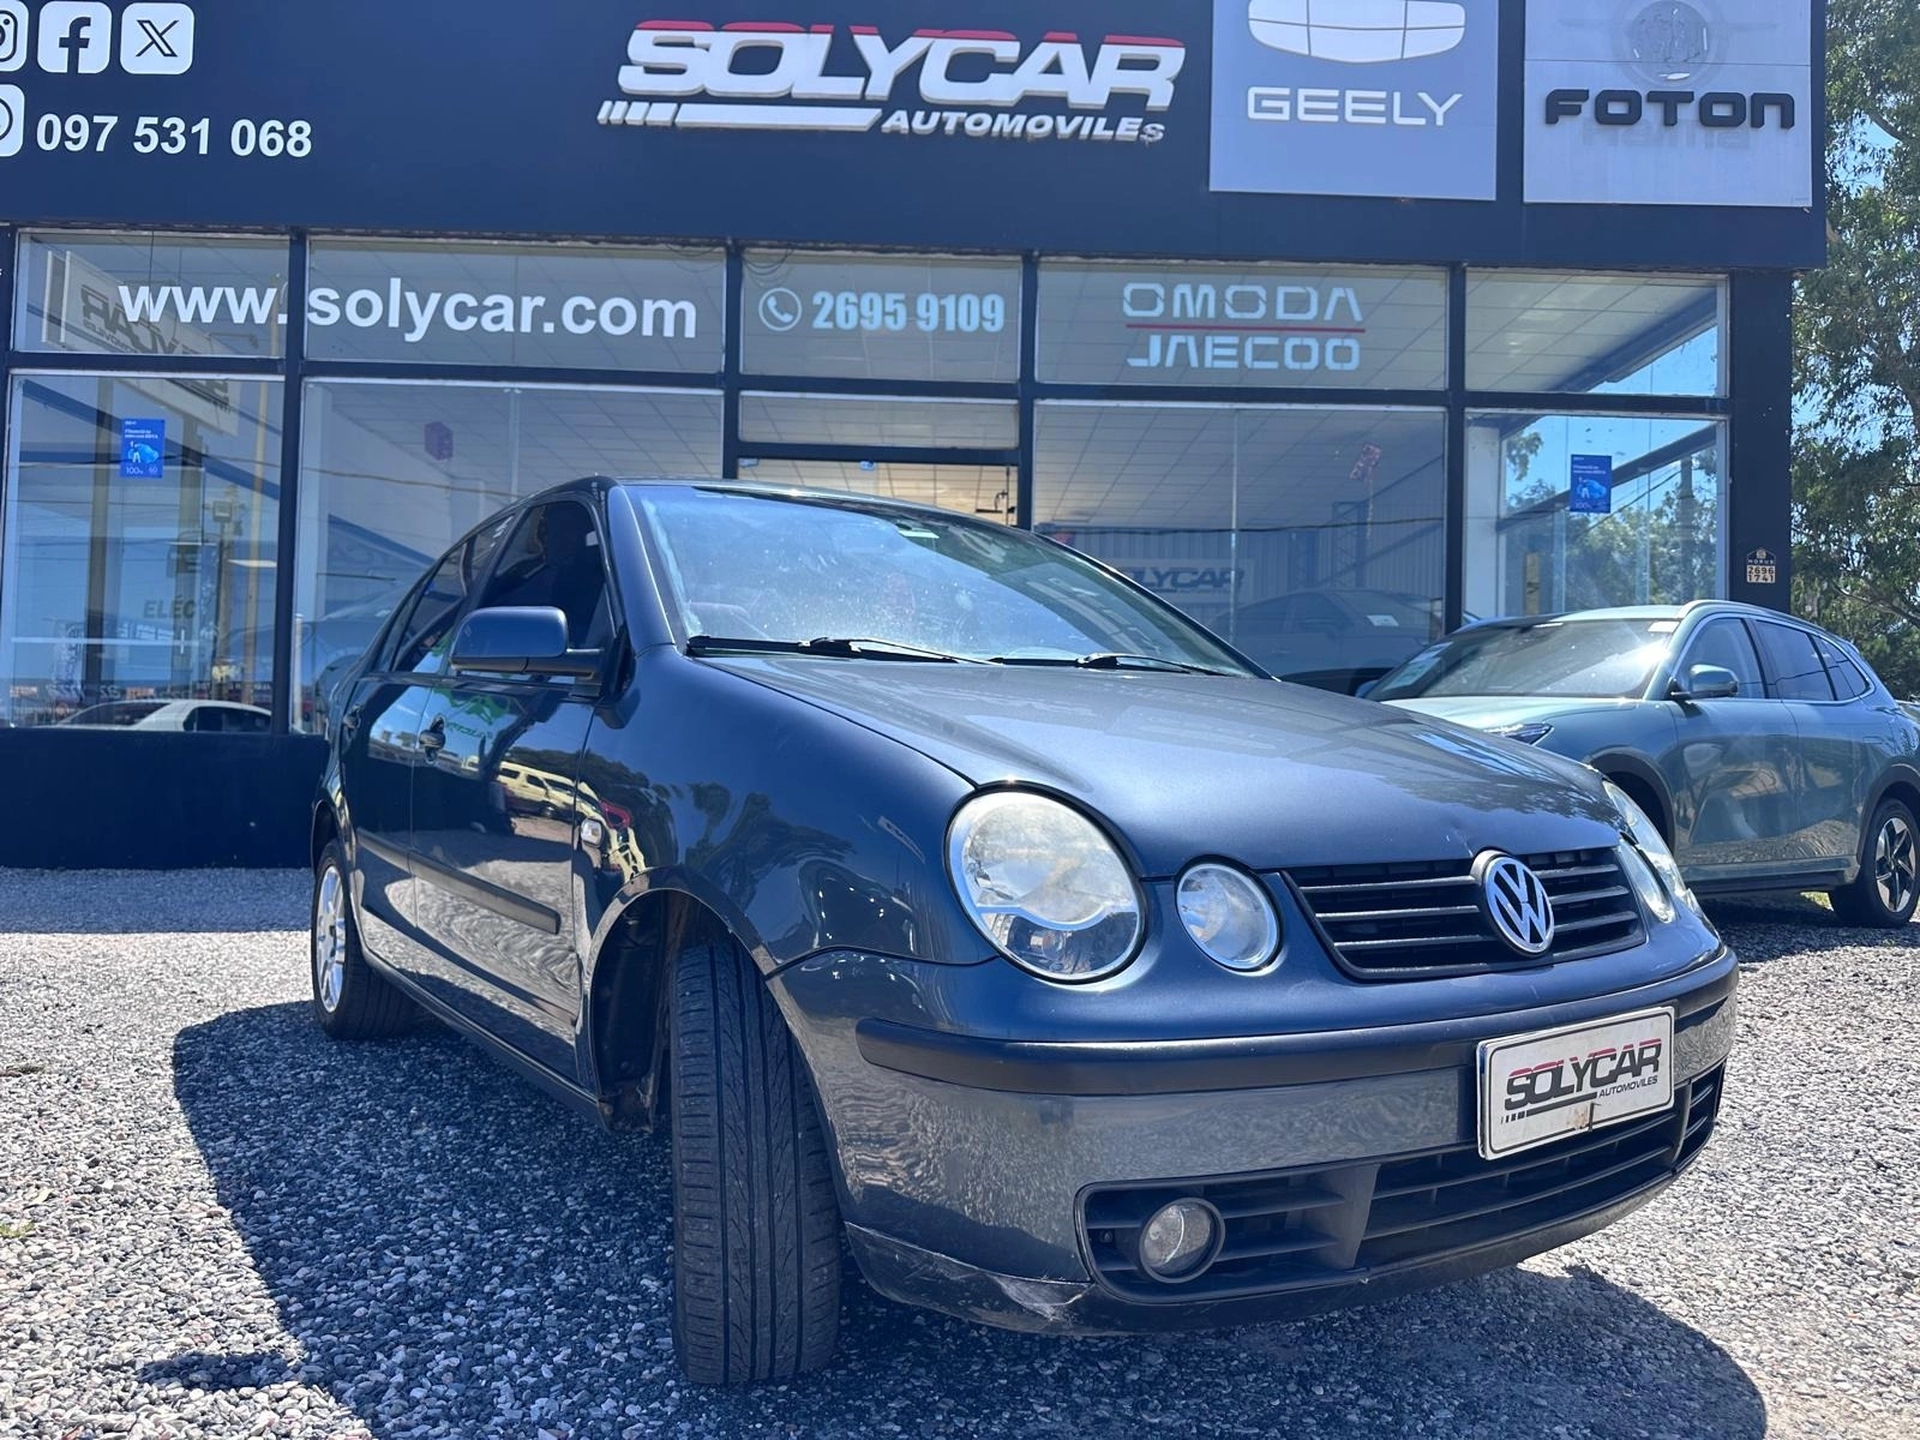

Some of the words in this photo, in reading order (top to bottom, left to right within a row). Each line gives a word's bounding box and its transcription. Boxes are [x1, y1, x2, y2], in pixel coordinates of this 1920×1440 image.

[617, 20, 1186, 111] SOLYCAR
[1247, 86, 1463, 126] GEELY
[1545, 88, 1795, 129] FOTON
[36, 113, 118, 152] 097
[133, 116, 210, 155] 531
[230, 119, 312, 158] 068
[882, 110, 1166, 145] AUTOMOVILES
[307, 277, 696, 342] solycar.com
[812, 290, 907, 331] 2695
[916, 292, 1005, 333] 9109
[1122, 282, 1363, 322] OMODA
[1127, 335, 1360, 372] JAECOO
[1125, 566, 1245, 590] LYCAR
[1748, 566, 1774, 574] 2696
[1504, 1038, 1662, 1111] SOLYCAR
[1598, 1074, 1658, 1098] AUTOMOVILES
